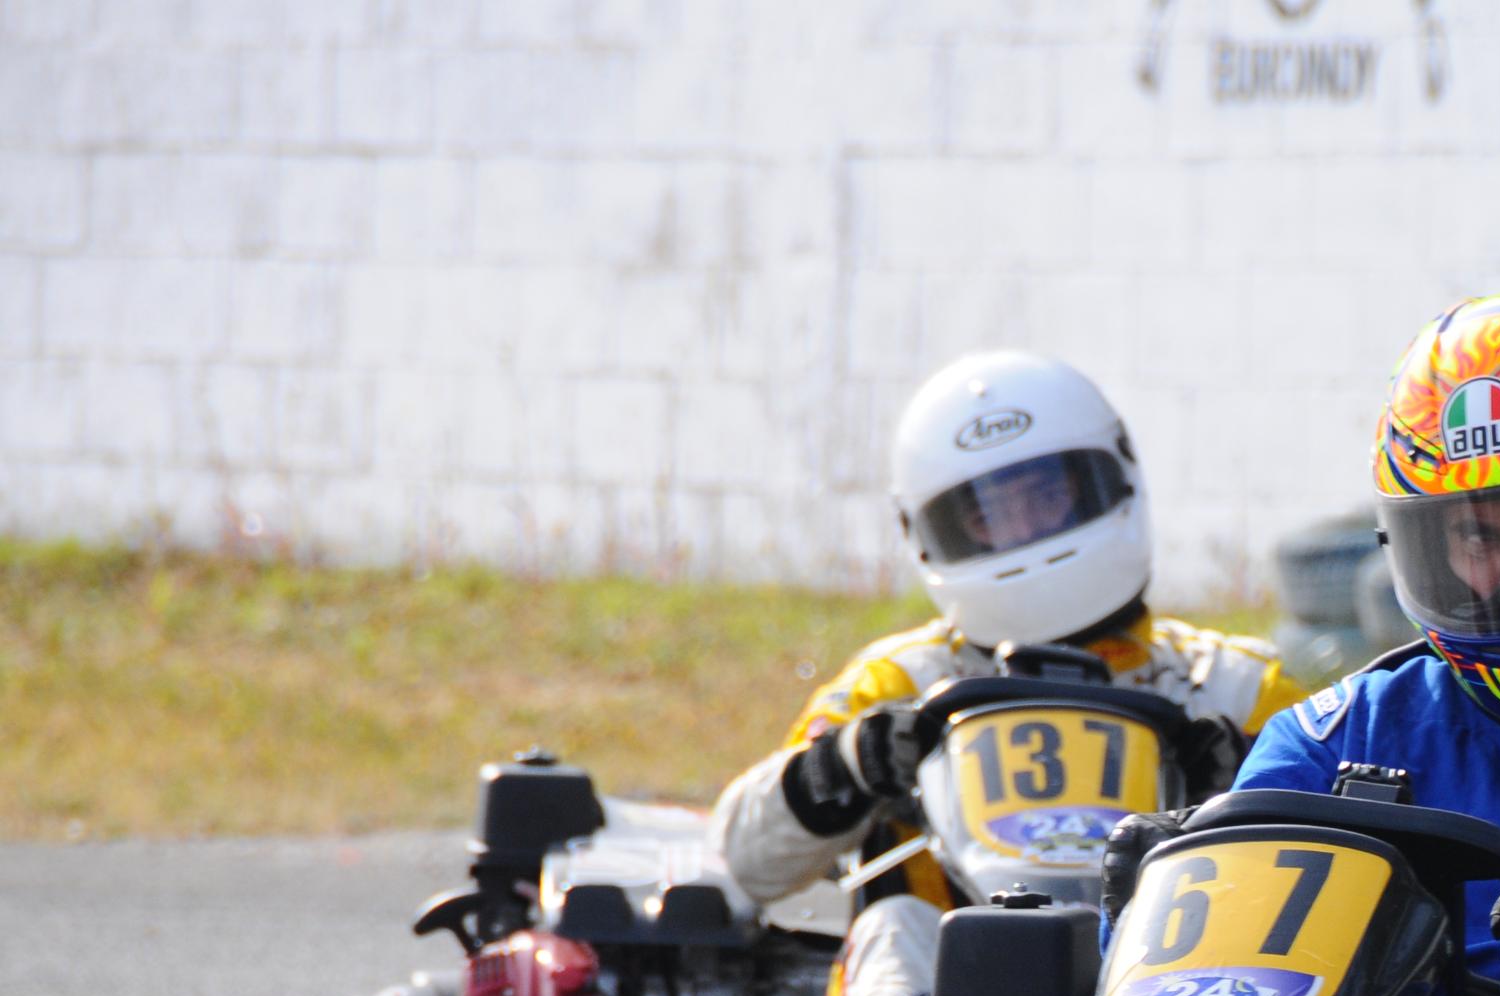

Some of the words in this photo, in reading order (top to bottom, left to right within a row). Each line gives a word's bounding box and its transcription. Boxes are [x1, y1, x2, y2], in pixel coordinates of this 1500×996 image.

[963, 409, 1028, 444] Arai
[962, 720, 1127, 804] 137
[1141, 849, 1335, 966] 67
